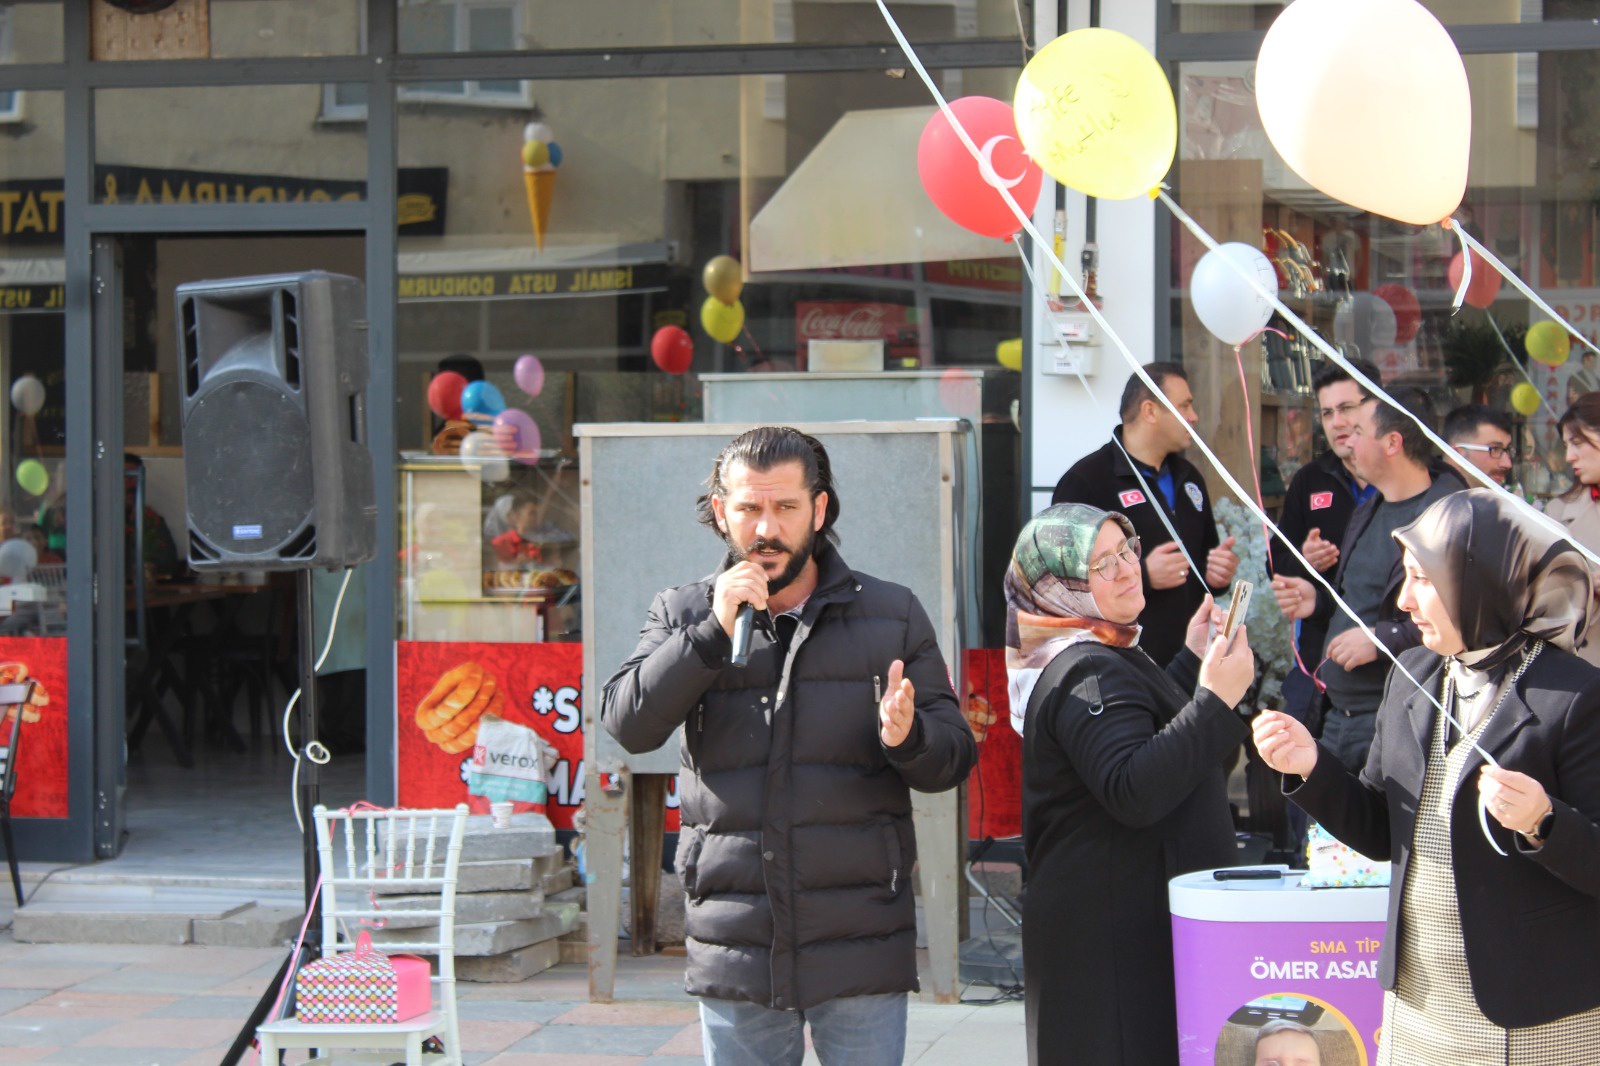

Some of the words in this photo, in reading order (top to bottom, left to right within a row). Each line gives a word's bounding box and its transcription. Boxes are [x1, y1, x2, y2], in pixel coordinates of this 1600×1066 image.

[489, 751, 539, 770] verox
[1310, 940, 1347, 954] SMA
[1355, 937, 1381, 954] TİP
[1251, 956, 1320, 979] ÖMER
